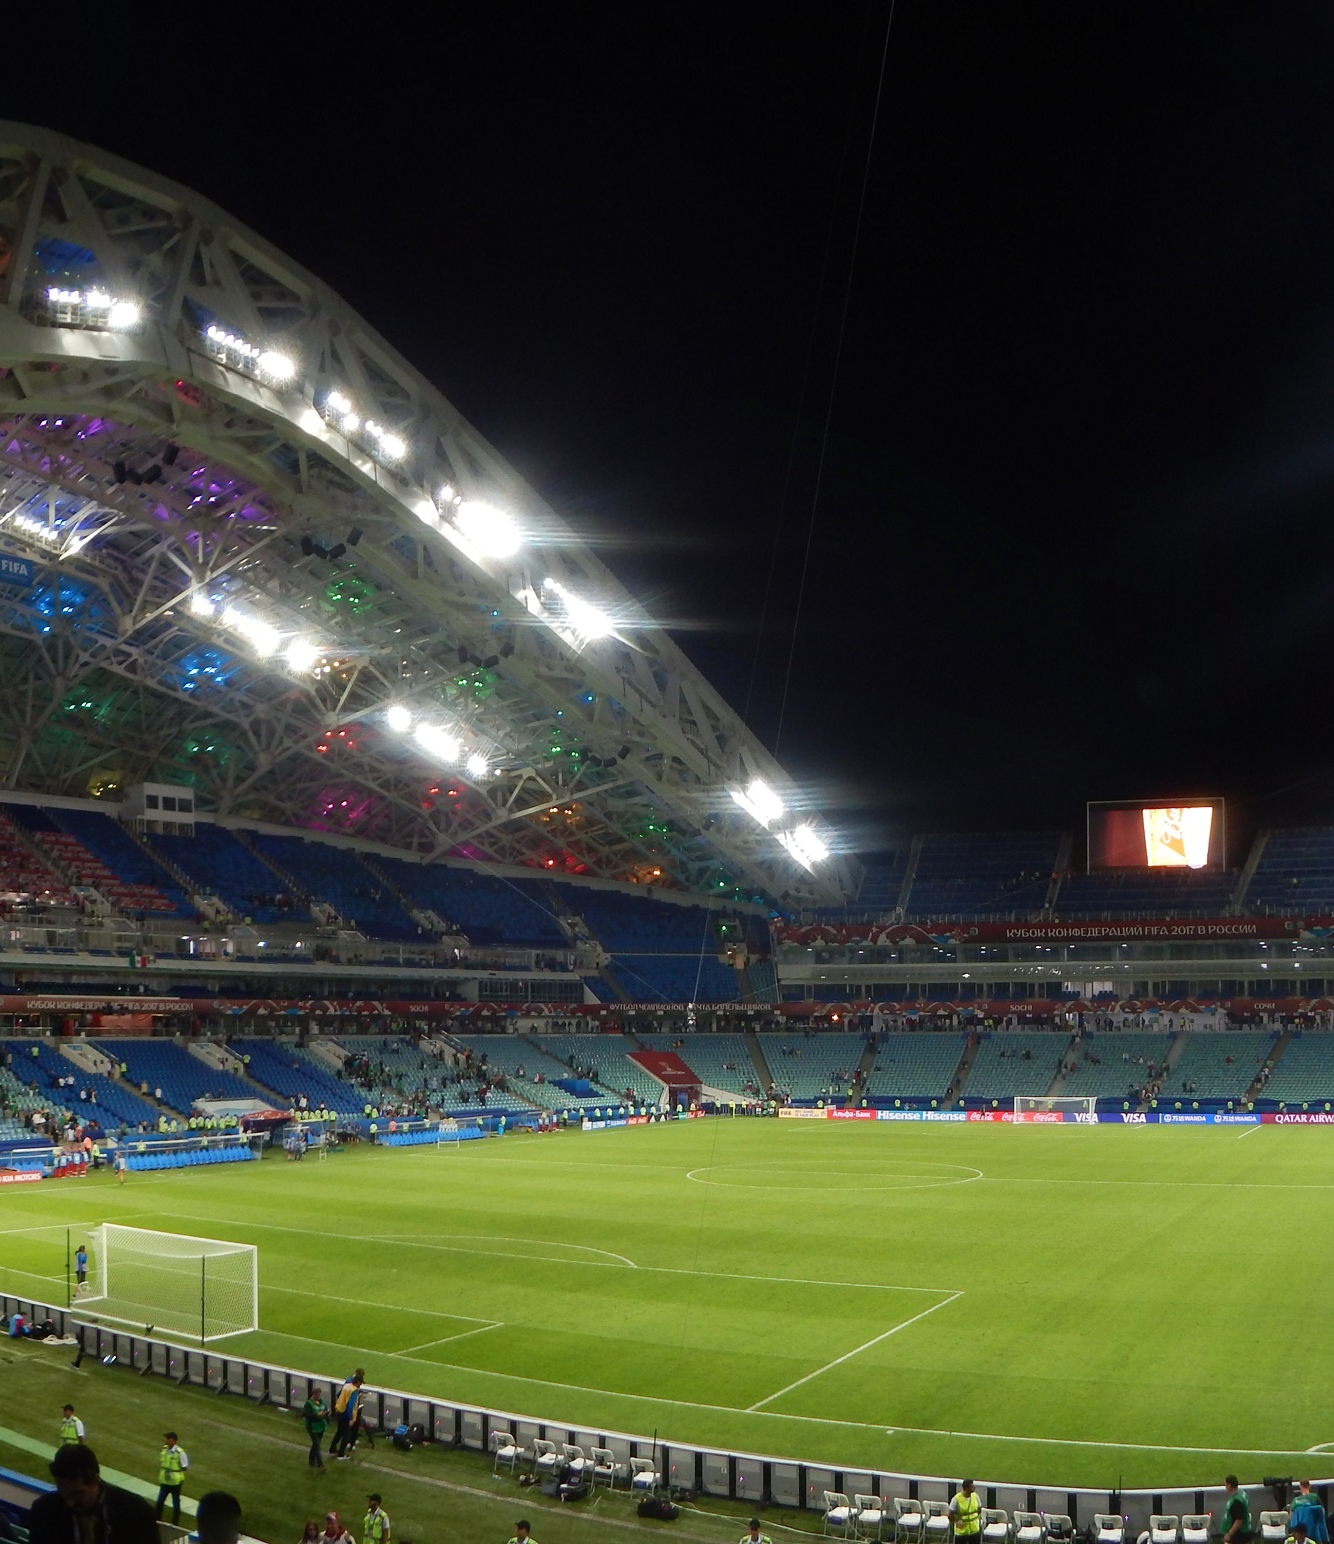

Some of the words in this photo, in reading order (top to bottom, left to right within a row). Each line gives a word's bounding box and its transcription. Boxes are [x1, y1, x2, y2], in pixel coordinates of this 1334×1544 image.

[1, 560, 28, 576] FIFA
[1006, 928, 1046, 938] КУБОК
[1048, 925, 1143, 937] КОНФЕДЕРАЦИЙ
[1144, 926, 1169, 936] FIFA
[1171, 925, 1196, 935] 2017
[1208, 924, 1257, 934] РОССИИ
[877, 1110, 921, 1120] Hisense
[923, 1110, 966, 1120] Hisense
[1074, 1113, 1099, 1122] VISA
[1121, 1113, 1146, 1122] VISA
[1275, 1114, 1307, 1124] QATAR
